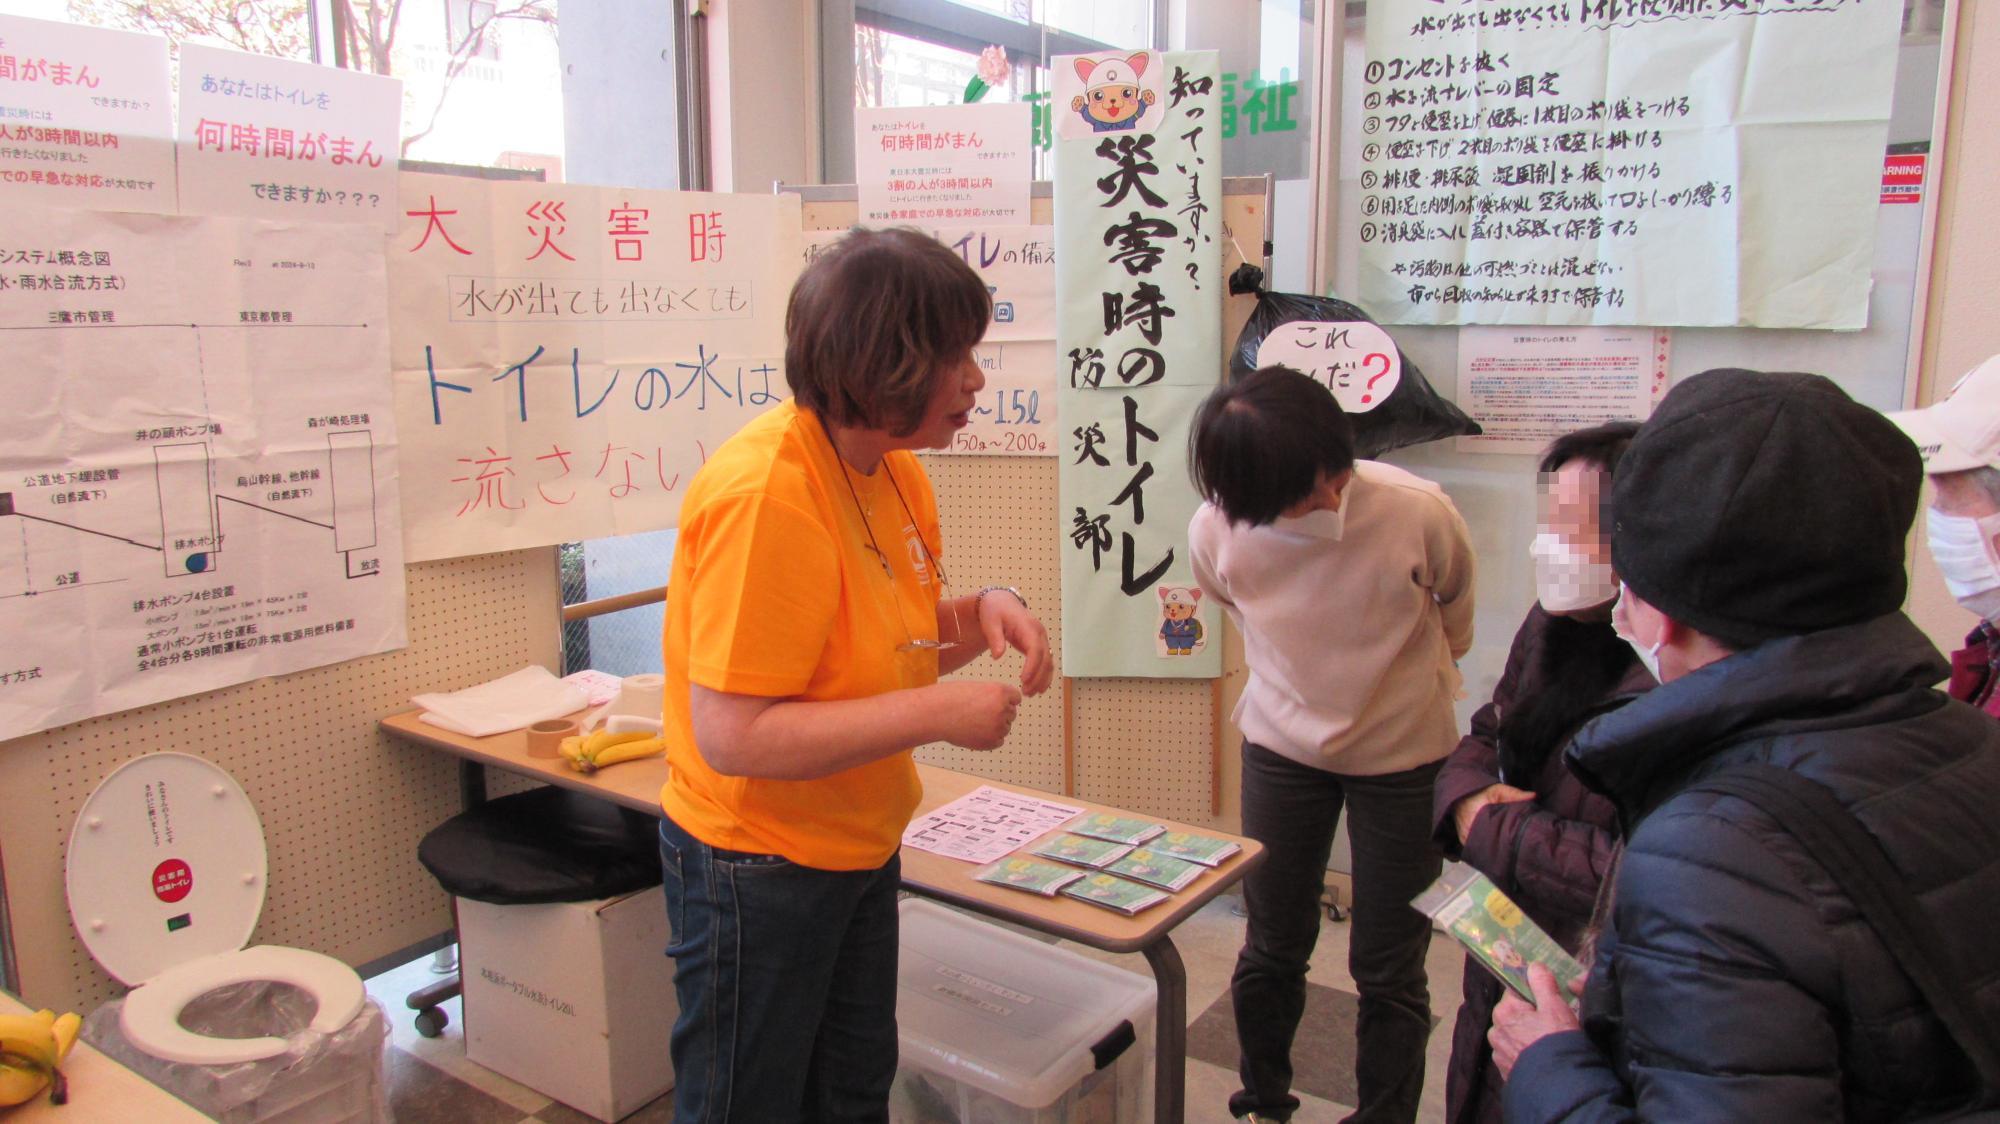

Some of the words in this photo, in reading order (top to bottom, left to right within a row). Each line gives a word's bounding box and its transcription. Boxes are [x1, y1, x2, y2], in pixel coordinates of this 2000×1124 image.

[201, 74, 330, 110] あなたはトイレを
[196, 118, 383, 169] 何時間がまん
[881, 132, 983, 152] 何時間がまん
[251, 183, 380, 209] できますか？？？
[887, 177, 993, 192] 3割の人が3時間以内
[456, 279, 747, 317] 水が出ても出なくても
[48, 311, 115, 324] 三鷹市管理
[1295, 327, 1356, 350] これ
[1096, 133, 1178, 596] 災害時のトイレ
[426, 344, 782, 426] トイレの水は
[1068, 347, 1112, 573] 防災部
